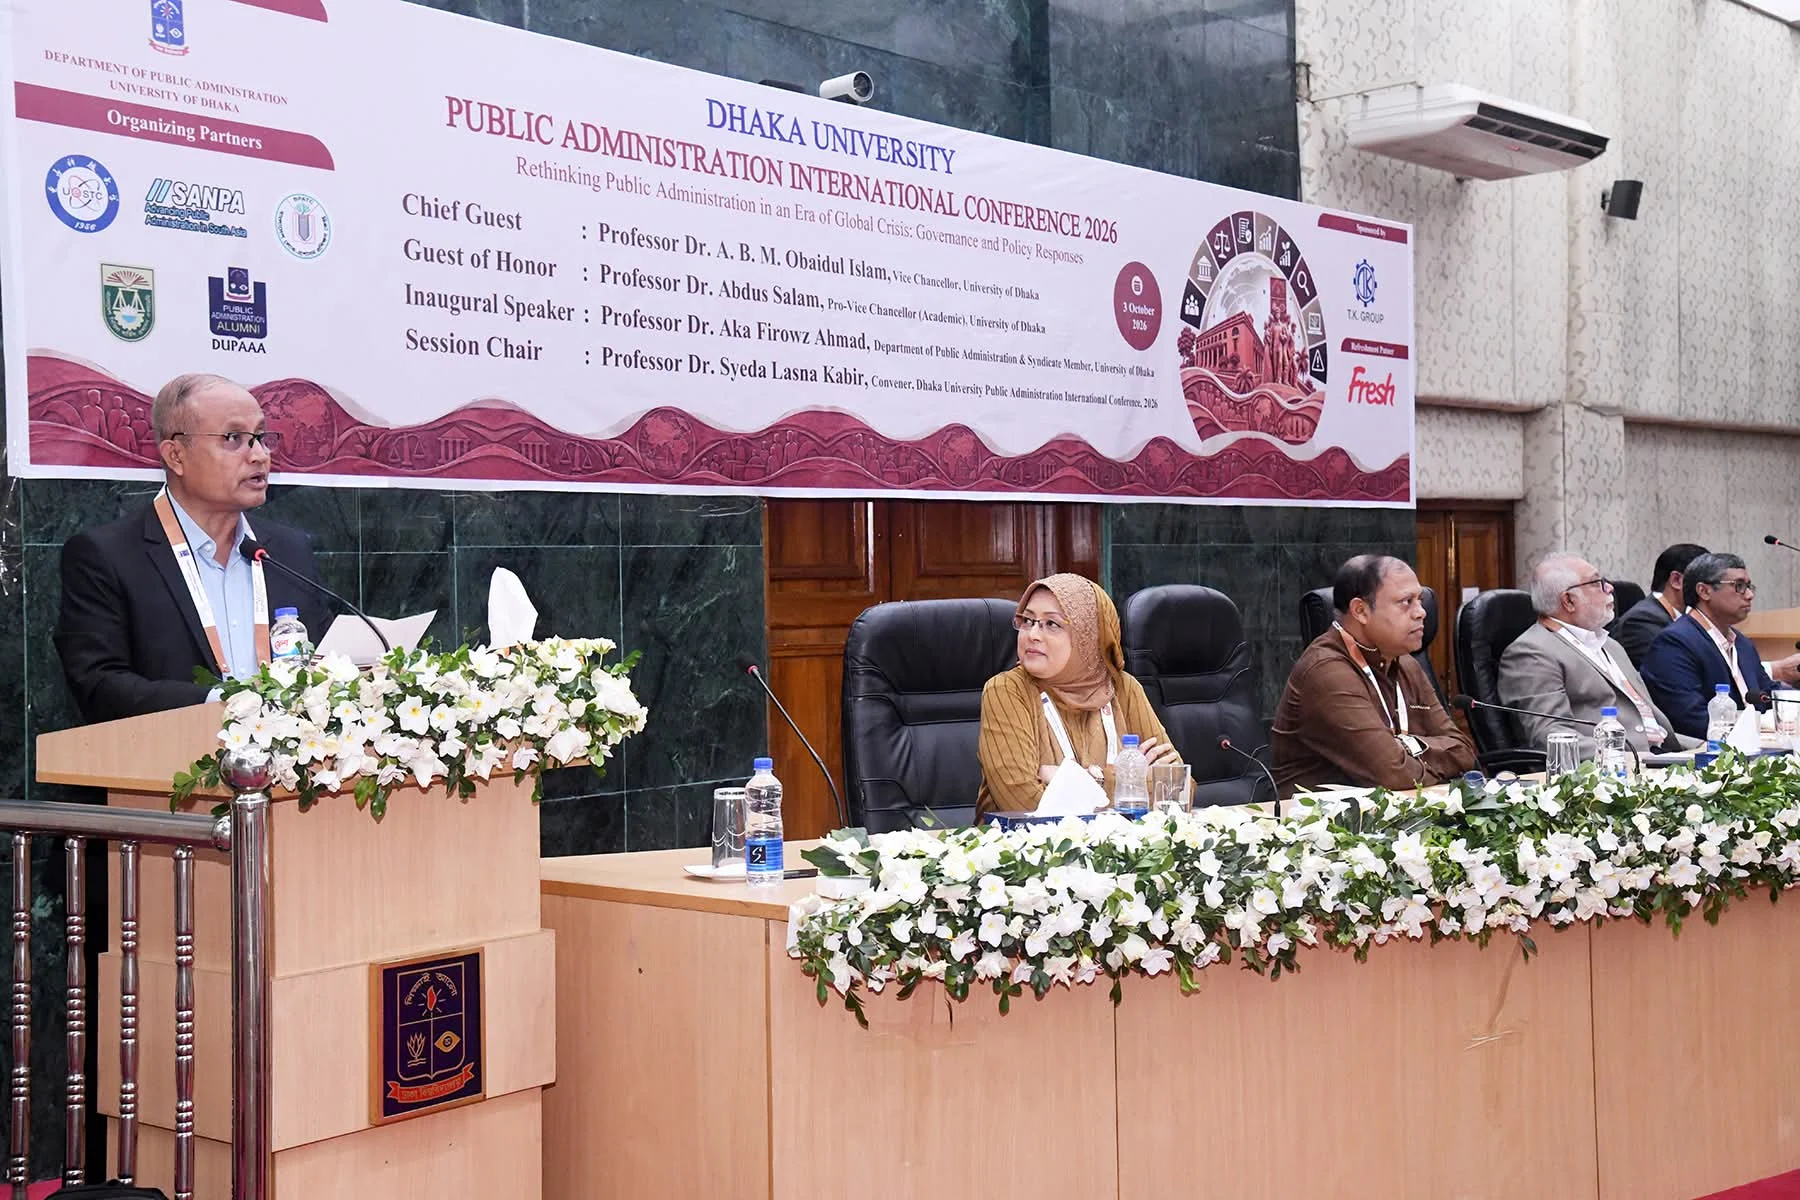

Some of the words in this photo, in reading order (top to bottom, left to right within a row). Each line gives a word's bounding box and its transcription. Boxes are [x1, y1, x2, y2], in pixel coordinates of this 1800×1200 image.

[44, 49, 129, 75] DEPARTMENT
[131, 67, 148, 79] OF
[150, 71, 192, 88] PUBLIC
[194, 80, 288, 105] ADMINISTRATION
[110, 79, 178, 102] UNIVERSITY
[183, 94, 198, 105] OF
[201, 97, 240, 113] DHAKA
[106, 108, 196, 142] Organizing
[199, 124, 262, 149] Partners
[705, 98, 807, 146] DHAKA
[811, 120, 956, 175] UNIVERSITY
[445, 95, 554, 145] PUBLIC
[560, 119, 784, 187] ADMINISTRATION
[788, 161, 960, 217] INTERNATIONAL
[964, 194, 1082, 238] CONFERENCE
[1084, 216, 1118, 244] 2026
[144, 202, 185, 220] Advancing
[185, 207, 210, 221] Public
[171, 181, 245, 215] SANPA
[516, 156, 601, 193] Rethinking
[605, 171, 651, 196] Public
[656, 181, 756, 214] Administration
[760, 197, 772, 216] in
[775, 204, 791, 219] an
[795, 203, 815, 223] Era
[818, 208, 832, 225] of
[834, 209, 874, 232] Global
[877, 217, 913, 238] Crisis:
[915, 223, 979, 248] Governance
[981, 236, 1000, 252] and
[1002, 237, 1033, 260] Policy
[1035, 243, 1084, 265] Responses
[144, 214, 200, 232] Administration
[199, 221, 208, 233] in
[208, 222, 231, 236] South
[230, 225, 248, 238] Asia
[402, 193, 461, 222] Chief
[465, 202, 523, 231] Guest
[598, 221, 680, 253] Professor
[684, 234, 712, 257] Dr.
[716, 240, 735, 260] A.
[739, 242, 756, 263] B.
[760, 245, 781, 267] M.
[785, 249, 845, 275] Obaidul
[848, 257, 892, 284] Islam,
[892, 270, 912, 284] Vice
[913, 272, 962, 291] Chancellor,
[963, 279, 1003, 299] University
[1005, 285, 1013, 297] of
[1014, 286, 1040, 301] Dhaka
[403, 238, 464, 267] Guest
[470, 248, 491, 270] of
[495, 249, 558, 278] Honor
[600, 263, 681, 293] Professor
[686, 274, 713, 297] Dr.
[718, 279, 769, 303] Abdus
[773, 285, 825, 313] Salam,
[827, 297, 867, 315] Pro-Vice
[869, 303, 917, 320] Chancellor
[969, 314, 1009, 333] University
[1010, 319, 1019, 332] of
[1020, 320, 1046, 335] Dhaka
[211, 311, 265, 324] ADMINISTRATION
[223, 305, 254, 315] PUBLIC
[1122, 301, 1128, 313] 3
[1128, 302, 1156, 317] October
[1131, 318, 1148, 331] 2026
[1347, 308, 1359, 321] T.K.
[1360, 311, 1385, 324] GROUP
[216, 321, 261, 335] ALUMNI
[405, 282, 499, 317] Inaugural
[503, 294, 575, 323] Speaker
[601, 304, 682, 333] Professor
[687, 314, 715, 336] Dr.
[719, 318, 751, 340] Aka
[756, 321, 811, 345] Firowz
[814, 328, 871, 354] Ahmad,
[874, 339, 924, 356] Department
[925, 345, 934, 357] of
[935, 346, 960, 359] Public
[961, 349, 1018, 365] Administration
[1019, 354, 1026, 366] &
[1027, 354, 1062, 369] Syndicate
[1063, 358, 1094, 372] Member,
[1094, 361, 1127, 377] University
[1128, 365, 1135, 376] of
[1135, 366, 1155, 378] Dhaka
[212, 338, 267, 354] DUPAAA
[406, 328, 480, 356] Session
[486, 336, 543, 361] Chair
[602, 346, 683, 373] Professor
[688, 353, 715, 375] Dr.
[720, 356, 767, 382] Syeda
[772, 360, 818, 383] Lasna
[823, 364, 869, 389] Kabir,
[871, 374, 915, 391] Convener,
[916, 378, 943, 392] Dhaka
[944, 381, 983, 398] University
[985, 384, 1008, 397] Public
[1009, 387, 1063, 402] Administration
[1064, 390, 1107, 405] International
[1108, 394, 1143, 409] Conference,
[1143, 398, 1159, 409] 2026
[1347, 366, 1396, 407] Fresh
